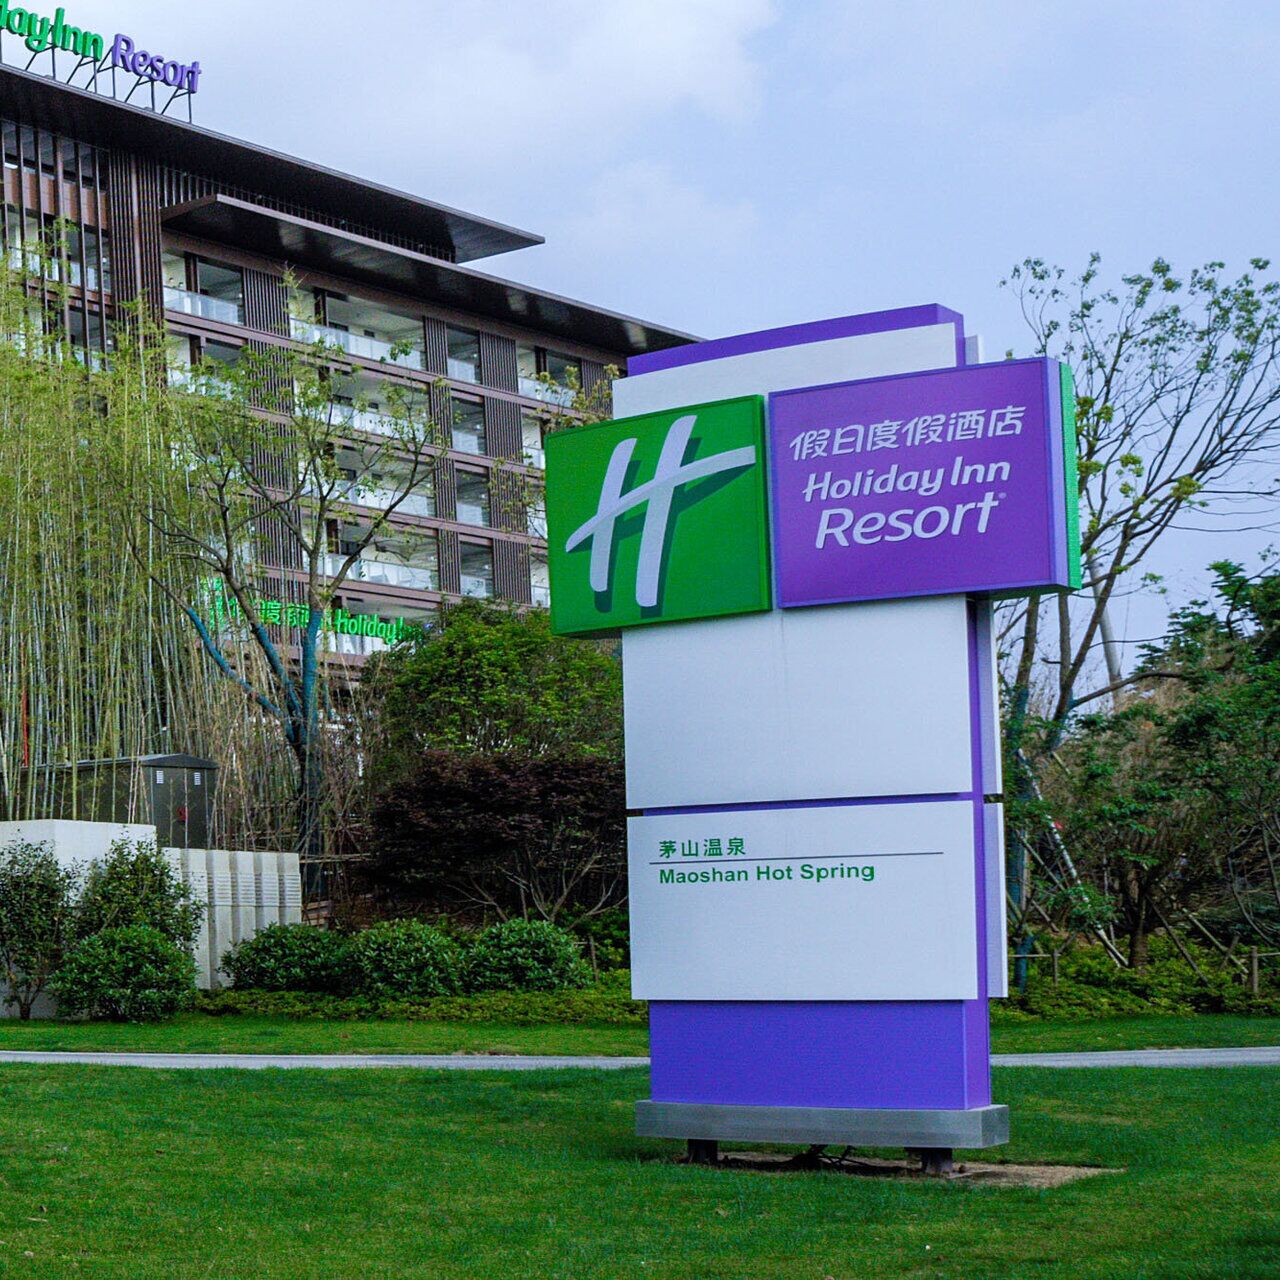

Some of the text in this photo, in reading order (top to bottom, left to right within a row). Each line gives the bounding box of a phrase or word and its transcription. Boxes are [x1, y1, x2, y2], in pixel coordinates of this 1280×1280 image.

[53, 7, 104, 62] Inn
[111, 33, 202, 94] Resort
[790, 405, 1026, 461] 假日度假酒店
[802, 456, 1011, 503] Holiday Inn
[815, 492, 1000, 549] Resort
[334, 607, 397, 645] Holiday
[659, 837, 746, 859] 茅山温泉
[659, 863, 875, 884] Maoshan Hot Spring
